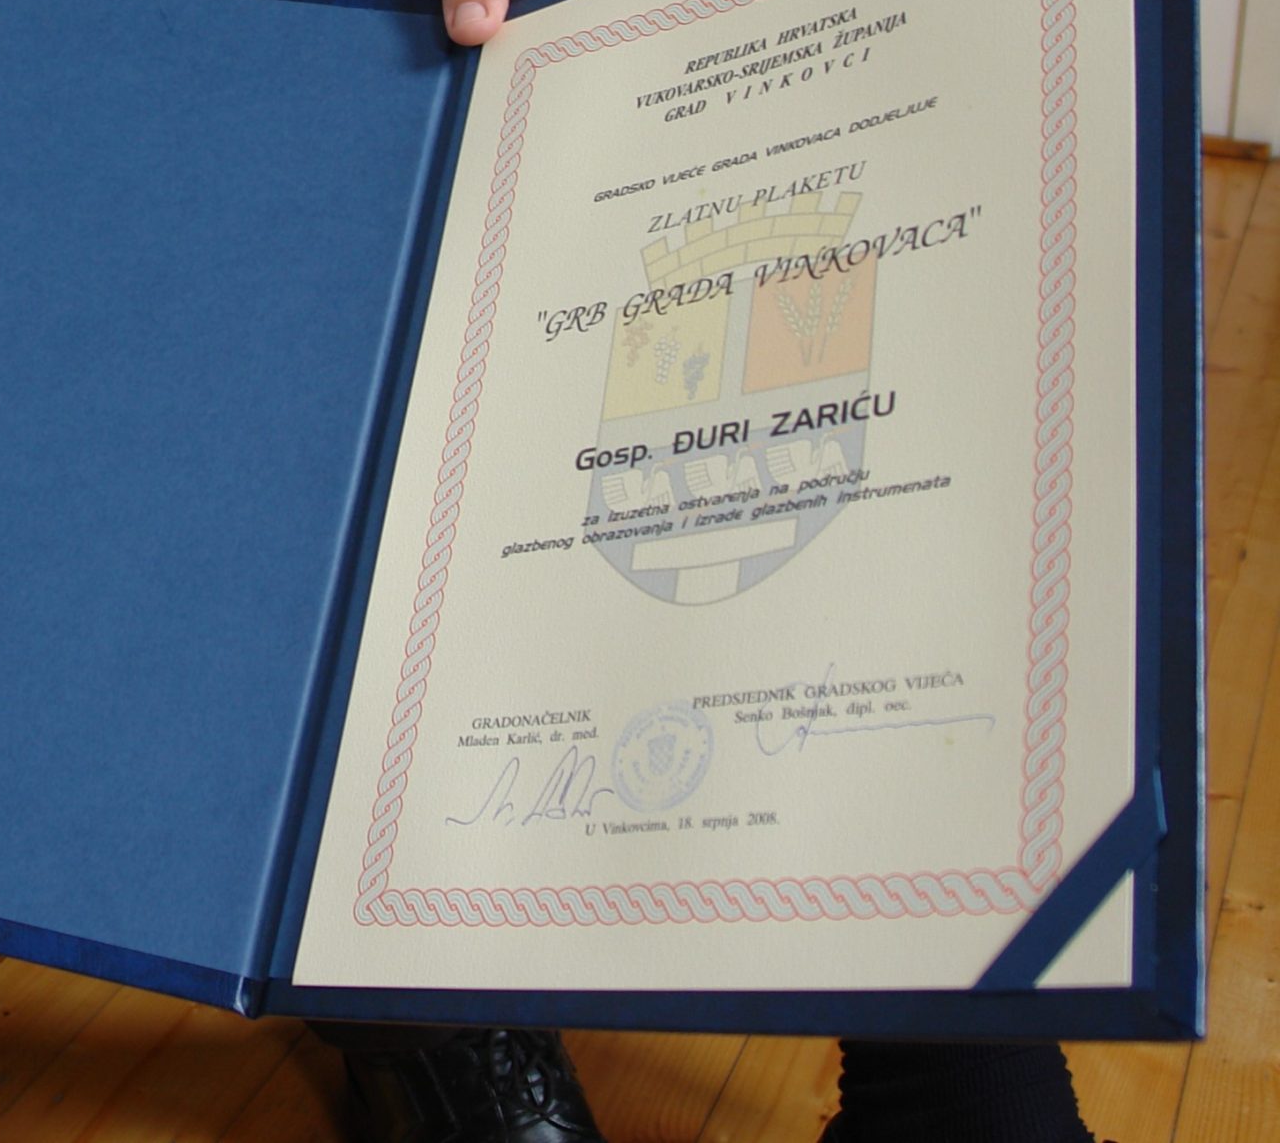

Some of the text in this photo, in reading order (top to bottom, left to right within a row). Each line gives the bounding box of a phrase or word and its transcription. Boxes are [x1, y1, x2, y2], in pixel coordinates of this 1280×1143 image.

[635, 10, 908, 109] VUKOVARSKO-SRIJEMSKA ŽUPANIJA
[684, 7, 858, 75] REPUBLIKA HRVATSKA
[664, 99, 707, 122] GRAD
[593, 96, 938, 203] GRADSKO VIJEĆE GRADA VINKOVACA DODJELJUJE
[647, 161, 868, 234] ZLATNU PLAKETU
[537, 205, 983, 342] "GRB GRADA VINKOVACA"
[575, 391, 897, 471] Gosp. ĐURI ZARIĆU
[501, 535, 575, 558] glazbenog
[581, 520, 674, 546] obrazovanja
[694, 508, 744, 528] izrade
[751, 493, 828, 520] glazbenih
[836, 474, 952, 505] instrumenata
[581, 514, 600, 527] za
[607, 503, 671, 523] izuzetna
[677, 486, 760, 512] ostvarenja
[769, 483, 789, 496] na
[692, 670, 965, 710] PREDSJEDNIK GRADSKOG VIJEĆA
[734, 709, 774, 724] Senko
[846, 700, 876, 718] dipl.
[458, 736, 500, 747] Mladen
[550, 729, 565, 742] dr.
[572, 727, 600, 741] med.
[472, 709, 593, 730] GRADONAČELNIK
[586, 824, 596, 836] U
[603, 818, 671, 836] Vinkovcima,
[678, 815, 695, 830] 18.
[702, 813, 740, 831] srpnja
